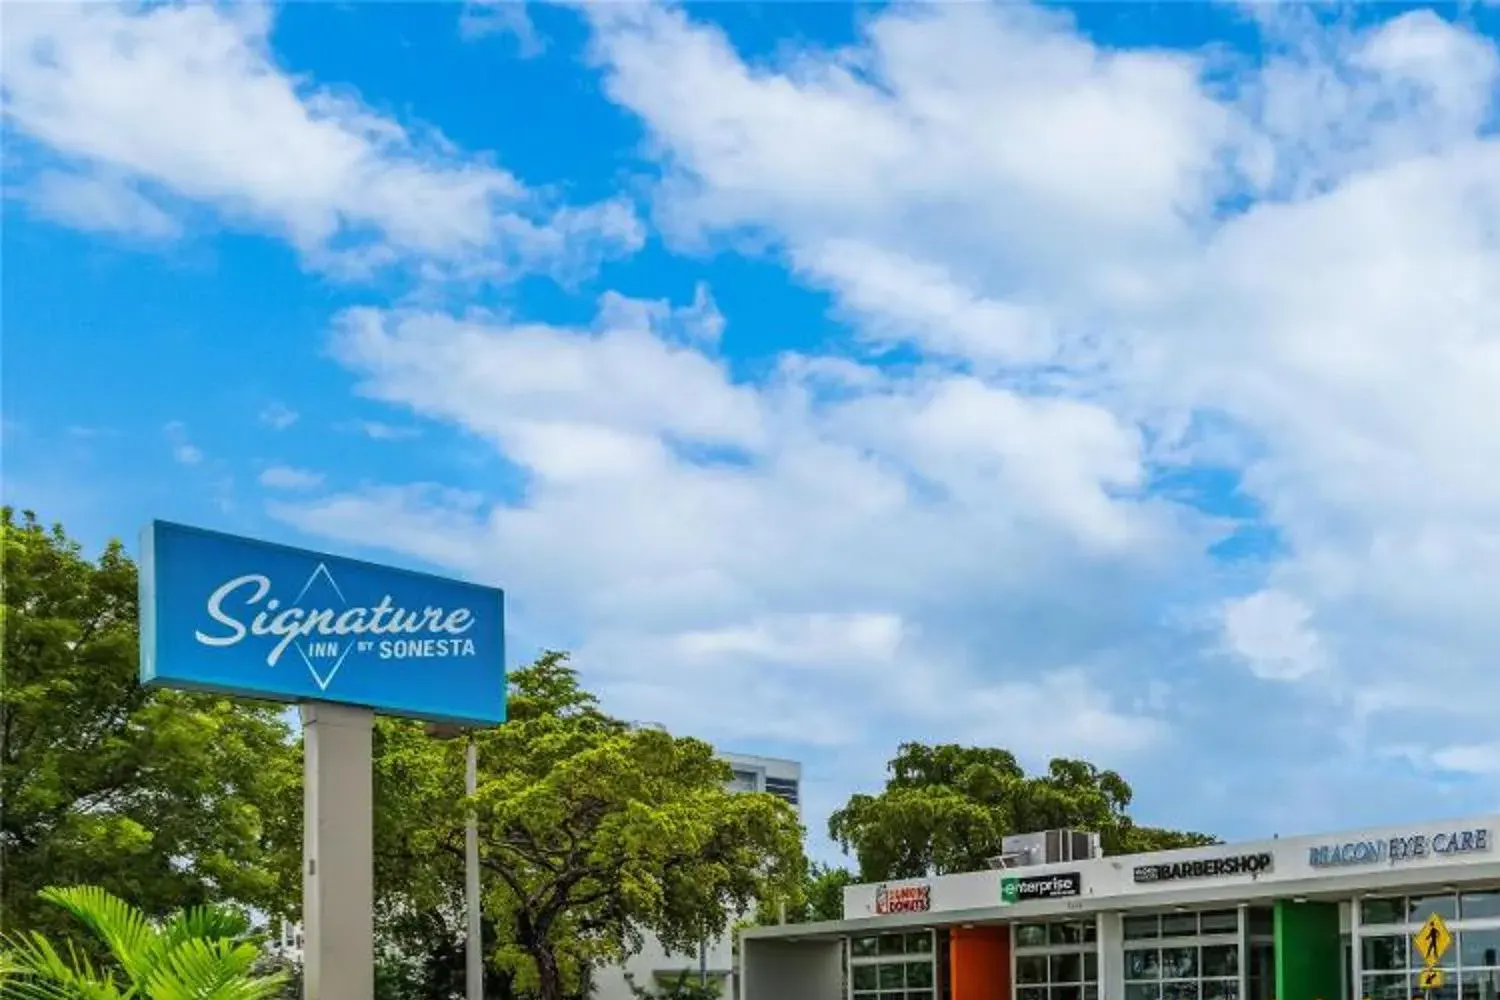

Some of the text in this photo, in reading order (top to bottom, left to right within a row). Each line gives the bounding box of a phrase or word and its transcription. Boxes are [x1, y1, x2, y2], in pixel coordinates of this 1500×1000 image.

[196, 575, 475, 667] Signature
[309, 640, 475, 658] INN BY SONESTA
[1389, 835, 1425, 859] EYE
[1433, 829, 1487, 853] CARE
[1158, 853, 1270, 880] BARBERSHOP
[1005, 877, 1073, 895] enterprise
